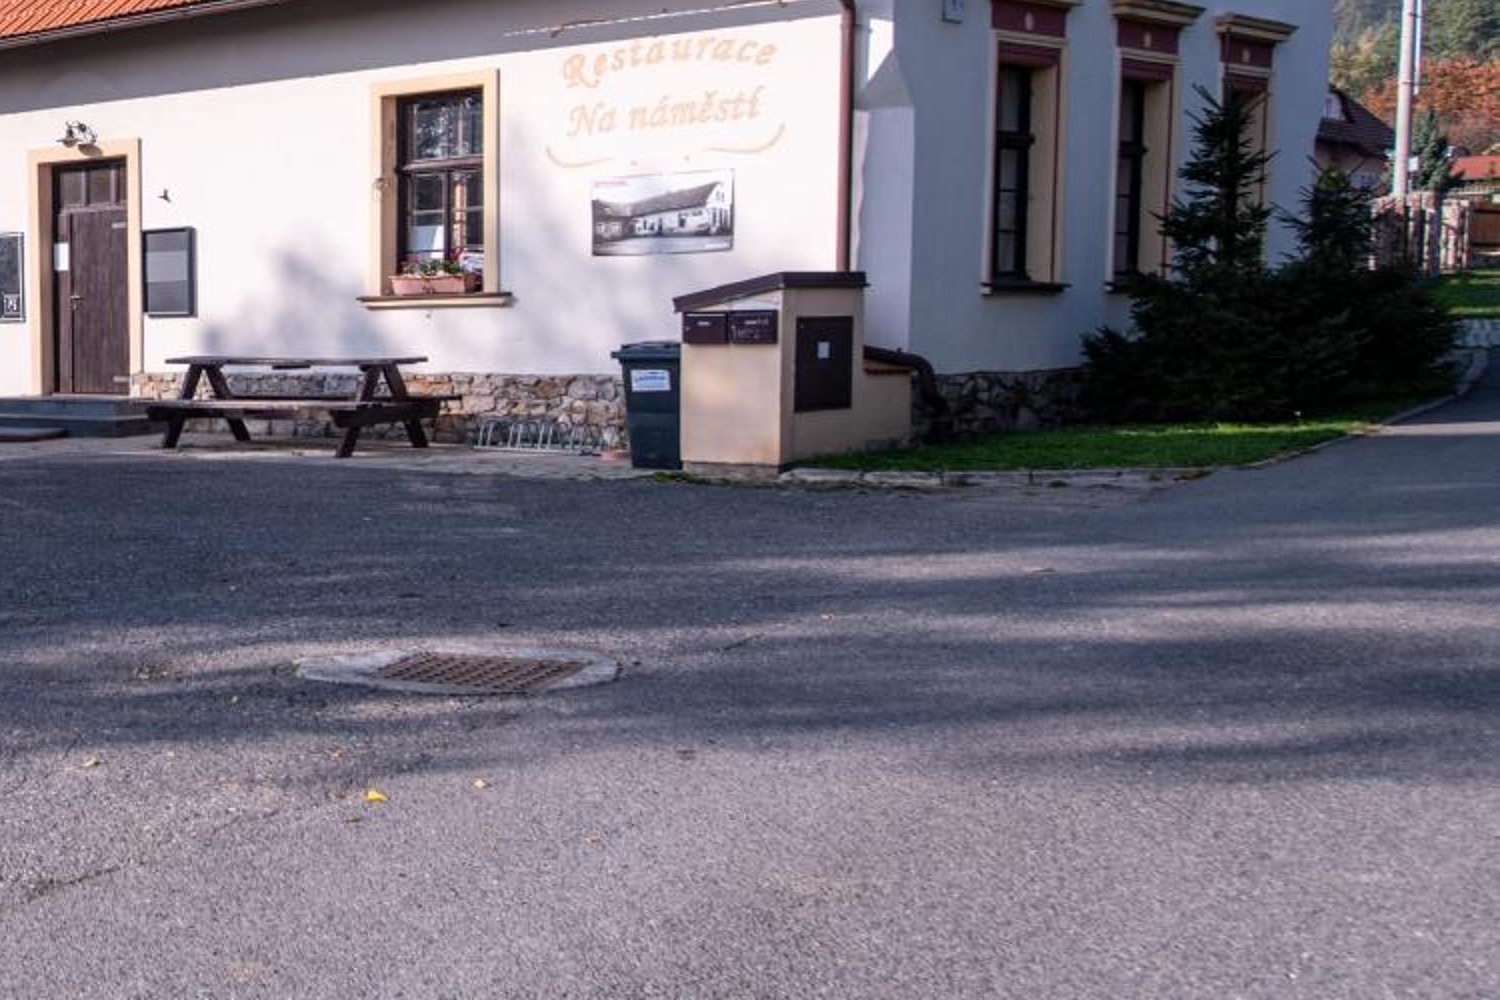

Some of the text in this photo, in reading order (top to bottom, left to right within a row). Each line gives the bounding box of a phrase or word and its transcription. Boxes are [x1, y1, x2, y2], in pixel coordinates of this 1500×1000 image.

[563, 37, 778, 89] Restaurace
[565, 85, 767, 137] Na náměstí
